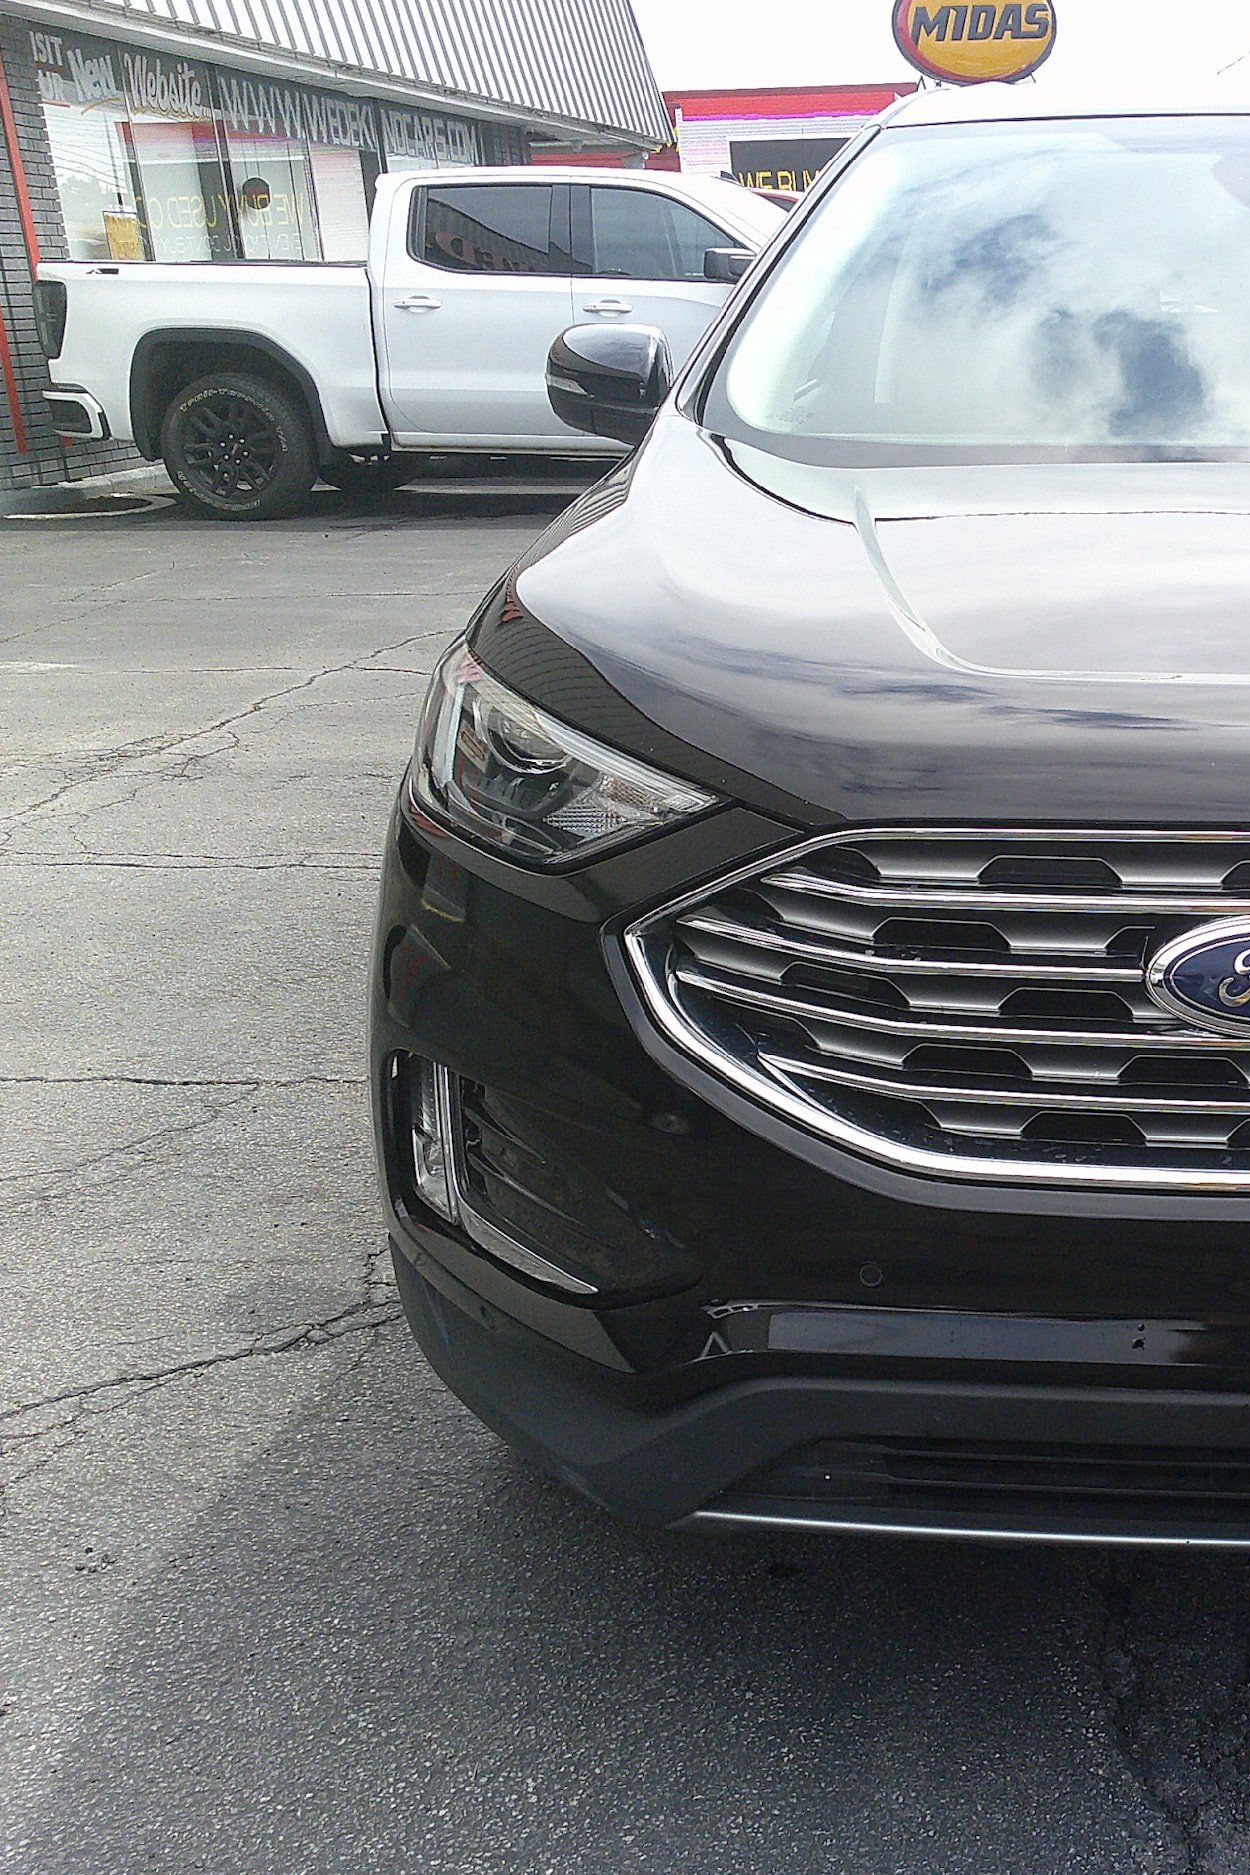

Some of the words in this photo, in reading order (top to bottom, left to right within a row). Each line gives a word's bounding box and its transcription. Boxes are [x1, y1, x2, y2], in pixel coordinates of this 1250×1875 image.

[911, 3, 1050, 48] MIDAS
[66, 48, 118, 102] New
[738, 171, 773, 190] WE
